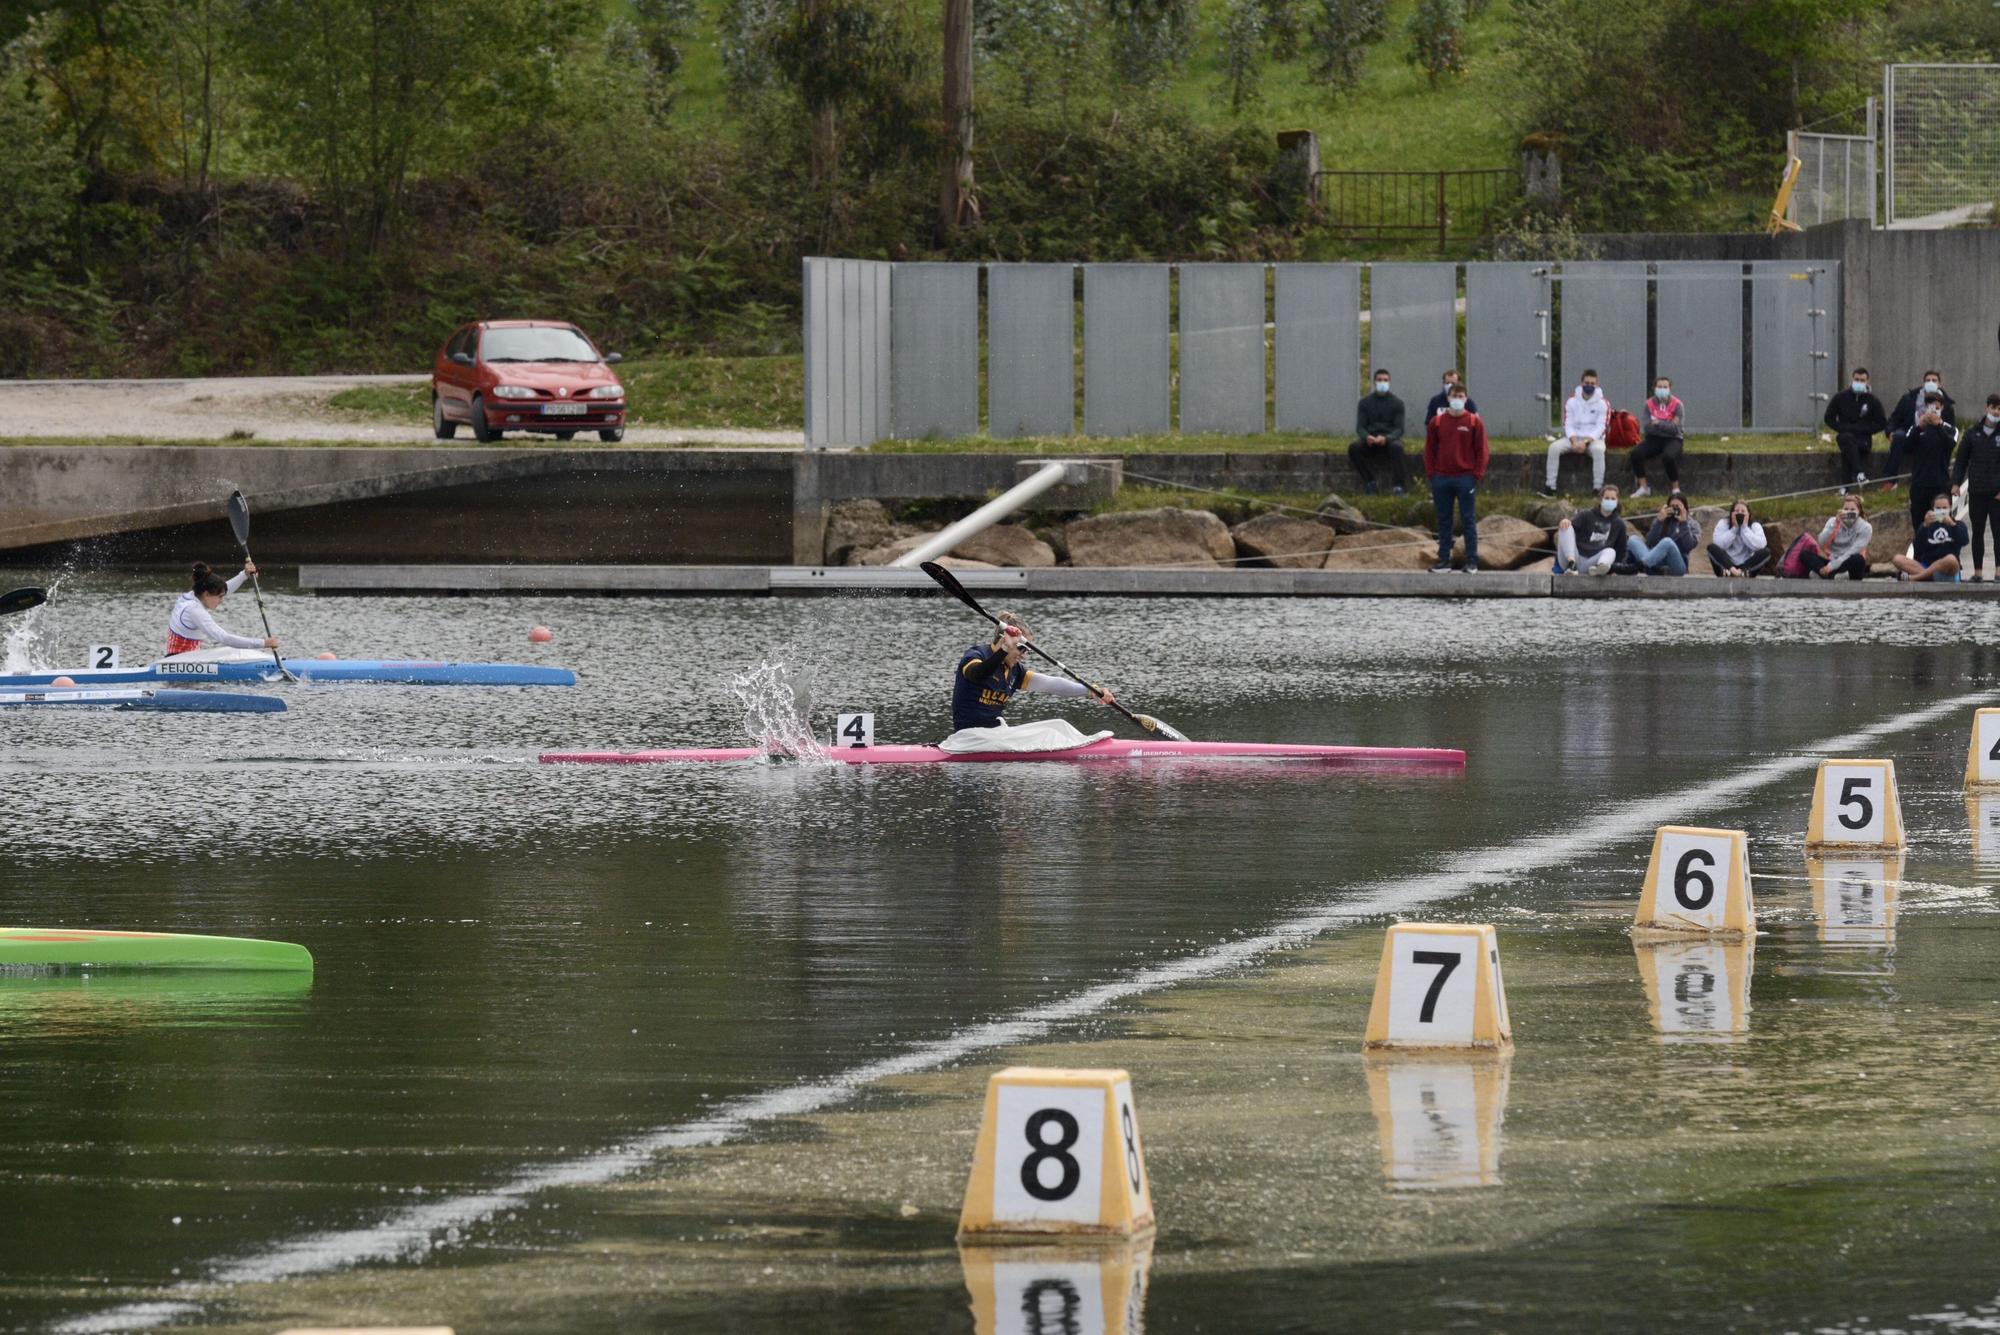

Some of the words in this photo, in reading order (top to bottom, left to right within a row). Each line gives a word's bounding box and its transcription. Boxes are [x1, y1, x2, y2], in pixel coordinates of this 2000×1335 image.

[96, 647, 114, 669] 2
[161, 664, 204, 674] FEIJOO
[207, 665, 217, 674] L.
[842, 715, 866, 741] 4
[1838, 778, 1874, 830] 5
[1674, 849, 1716, 911] 6
[1412, 950, 1461, 1023] 7
[1020, 1108, 1081, 1202] 8
[1123, 1103, 1140, 1195] 8
